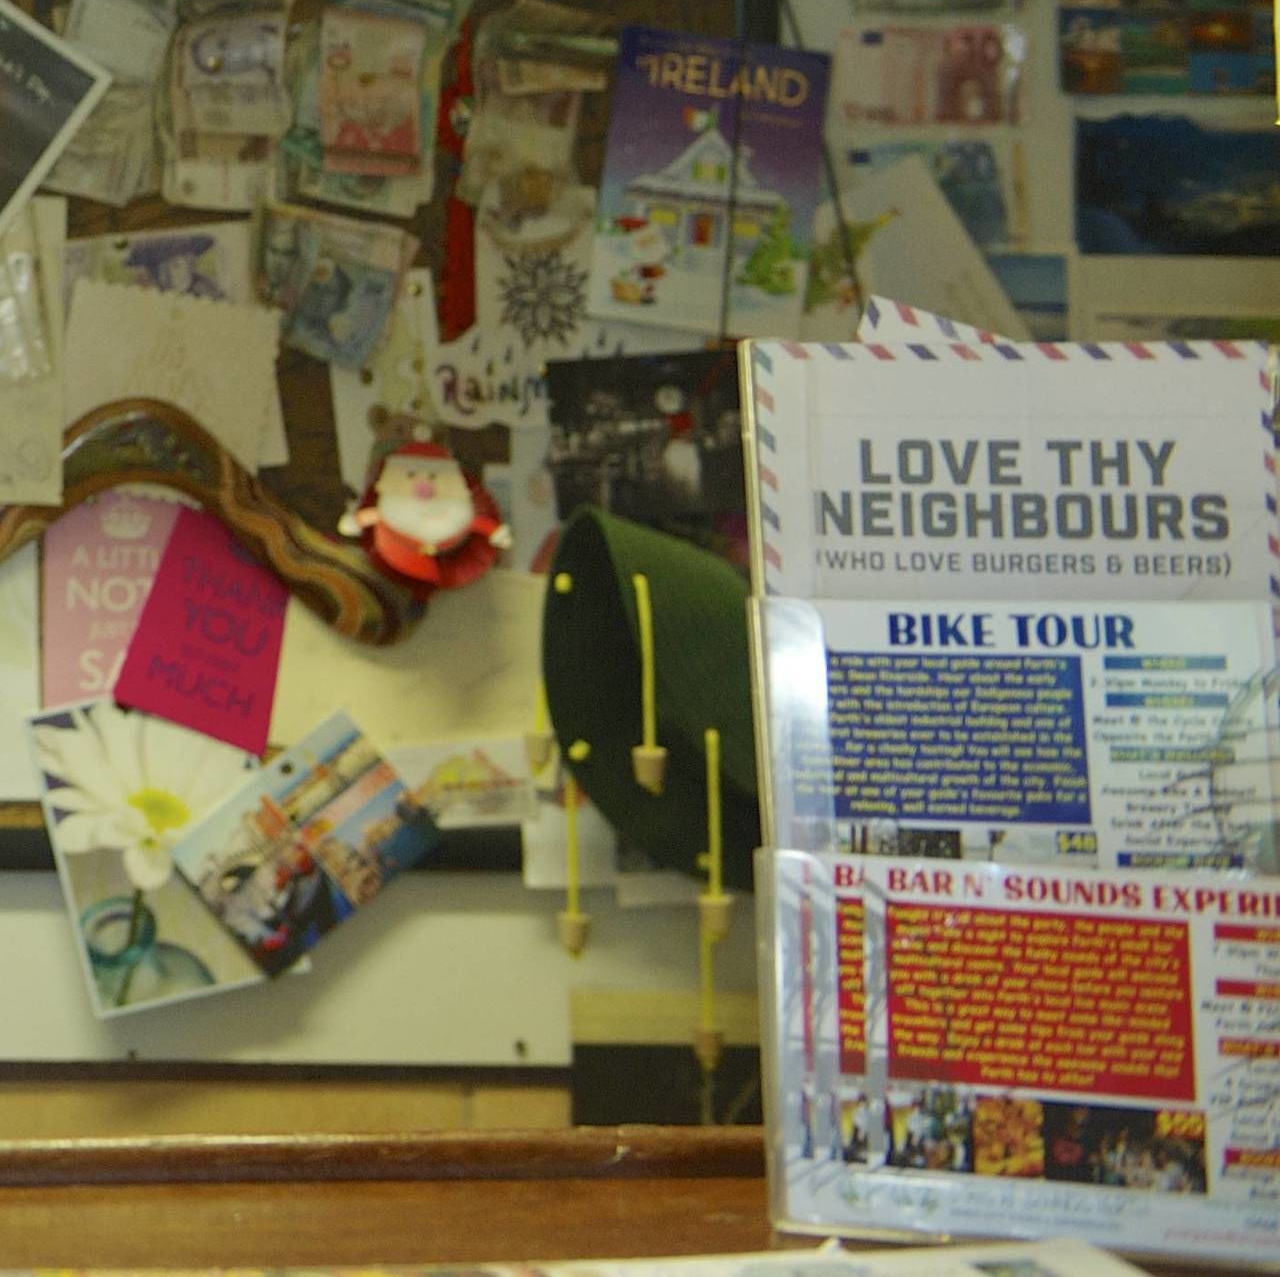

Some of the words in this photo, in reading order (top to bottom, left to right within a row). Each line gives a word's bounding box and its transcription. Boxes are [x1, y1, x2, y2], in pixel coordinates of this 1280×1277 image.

[647, 52, 810, 109] IRELAND
[859, 438, 1022, 486] LOVE
[1047, 440, 1177, 487] THY
[814, 490, 1231, 541] NEIGHBOURS
[895, 552, 962, 575] LOVE
[972, 552, 1097, 576] BURGERS
[1133, 552, 1233, 579] BEERS)
[184, 598, 269, 656] YOU
[887, 612, 996, 648] BIKE
[1008, 613, 1135, 650] TOUR
[148, 655, 256, 715] MUCH
[887, 866, 954, 898] BAR
[1003, 874, 1142, 909] SOUNDS
